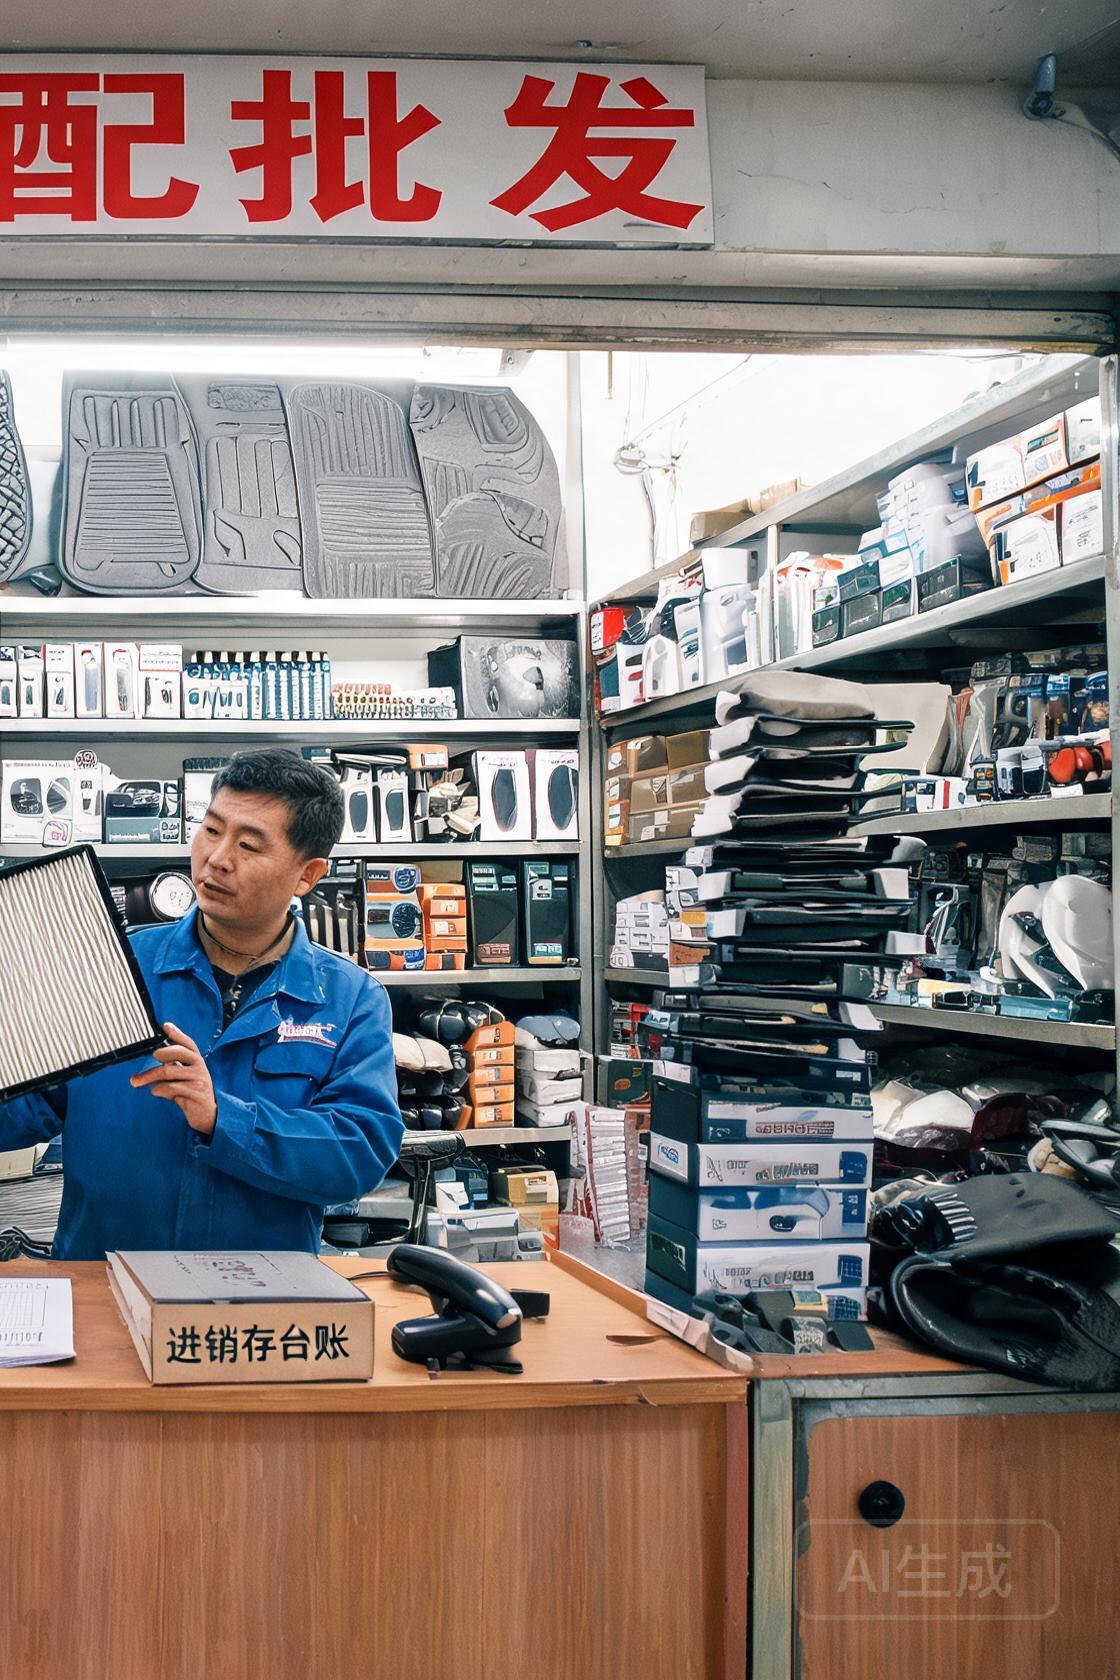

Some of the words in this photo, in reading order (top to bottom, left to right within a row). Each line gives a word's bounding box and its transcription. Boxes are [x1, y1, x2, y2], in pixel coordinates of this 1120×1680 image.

[166, 1323, 350, 1363] 进销存台账
